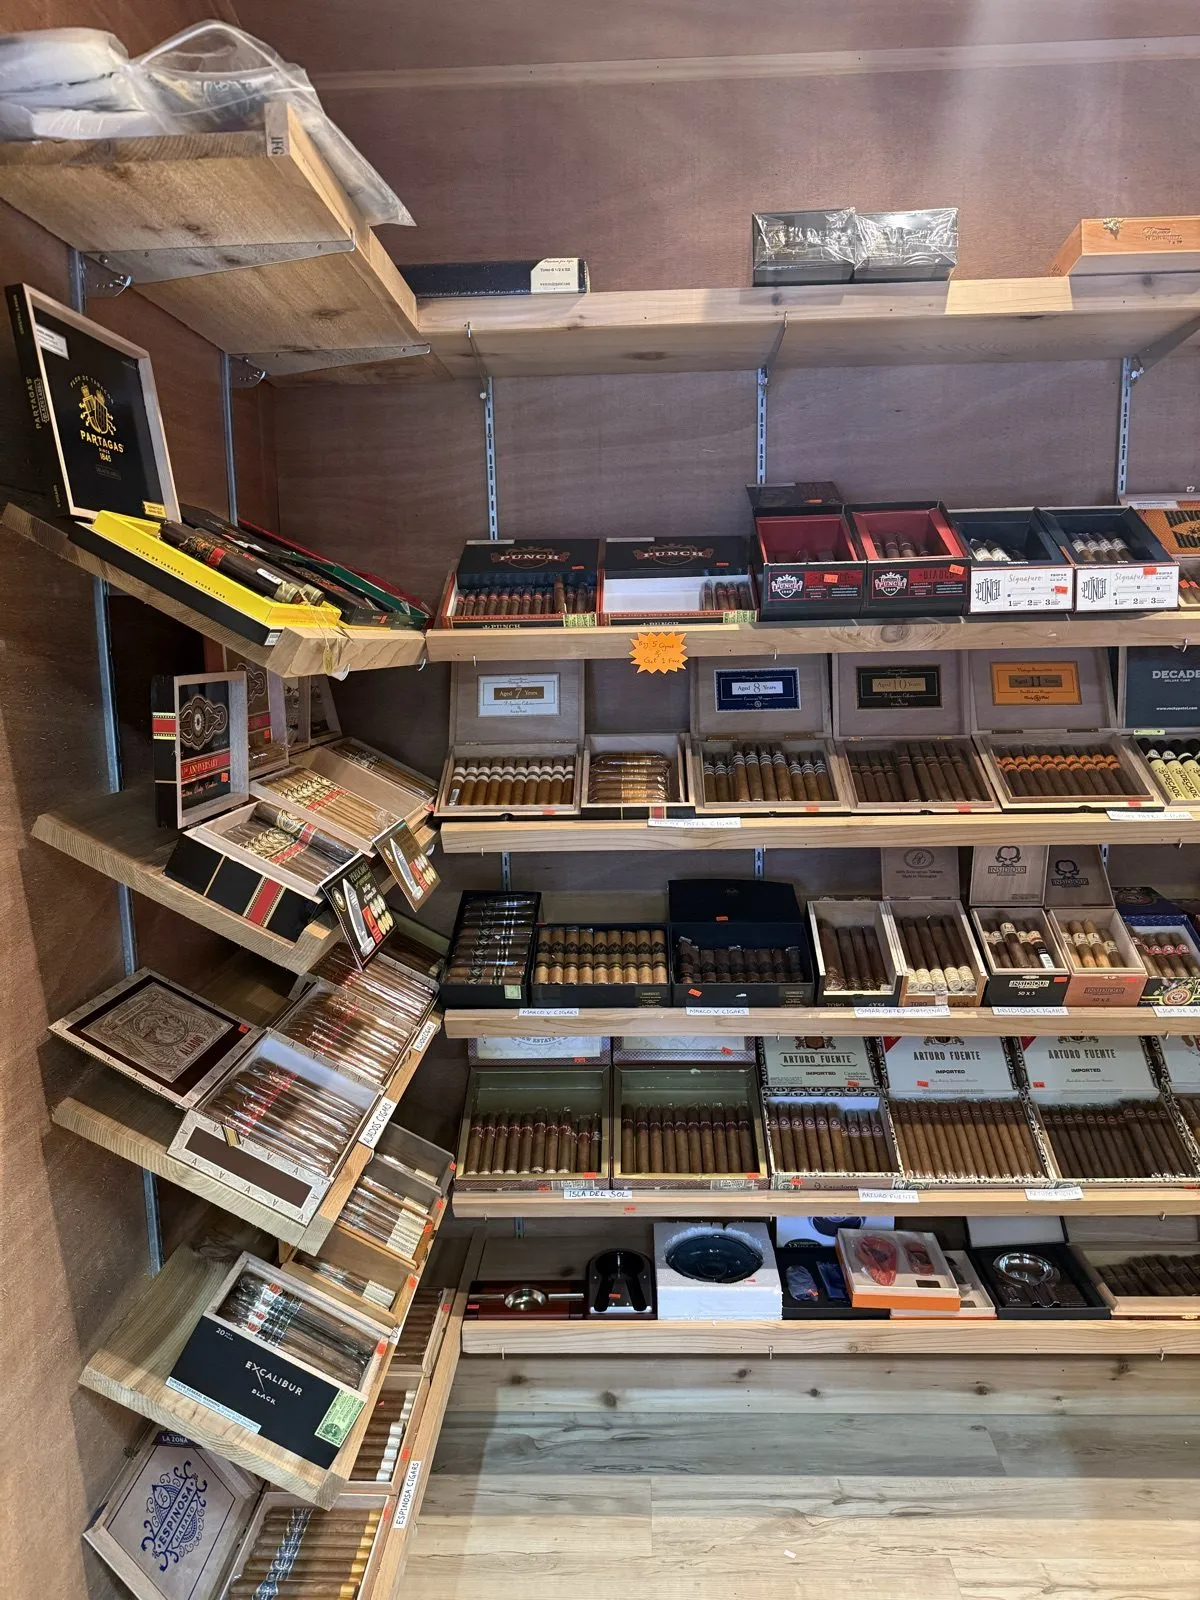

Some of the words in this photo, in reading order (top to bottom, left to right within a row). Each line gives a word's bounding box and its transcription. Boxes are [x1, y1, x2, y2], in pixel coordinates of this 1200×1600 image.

[25, 377, 42, 430] PARTAGAS
[80, 429, 124, 453] PARTAGAS
[100, 452, 112, 462] 1845
[500, 553, 560, 561] PUNCH
[644, 550, 704, 558] PUNCH
[1008, 574, 1042, 584] Signature
[975, 578, 1001, 604] PUNCH
[1081, 577, 1107, 603] PUNCH
[1152, 670, 1200, 679] DECADE
[754, 682, 760, 693] 8
[894, 680, 907, 689] 10
[515, 688, 522, 699] 7
[1163, 773, 1182, 799] DECADE
[1181, 773, 1199, 799] DECADE
[988, 866, 1026, 874] INSIDIOUS
[179, 1033, 206, 1058] ALIADOS
[783, 1055, 816, 1063] ARTURO
[820, 1055, 851, 1063] FUENTE
[913, 1051, 946, 1060] ARTURO
[950, 1051, 981, 1060] FUENTE
[1048, 1050, 1081, 1059] ARTURO
[1085, 1049, 1116, 1058] FUENTE
[363, 1123, 381, 1144] ALIADOS
[376, 1102, 392, 1121] CIGARS
[216, 1328, 225, 1336] 20
[245, 1360, 303, 1396] EXCALIBUR
[251, 1388, 276, 1405] BLACK
[396, 1489, 412, 1525] ESPINOSA
[407, 1462, 419, 1487] CIGARS
[159, 1486, 193, 1546] ESPINOSA
[175, 1506, 195, 1541] HABANO
